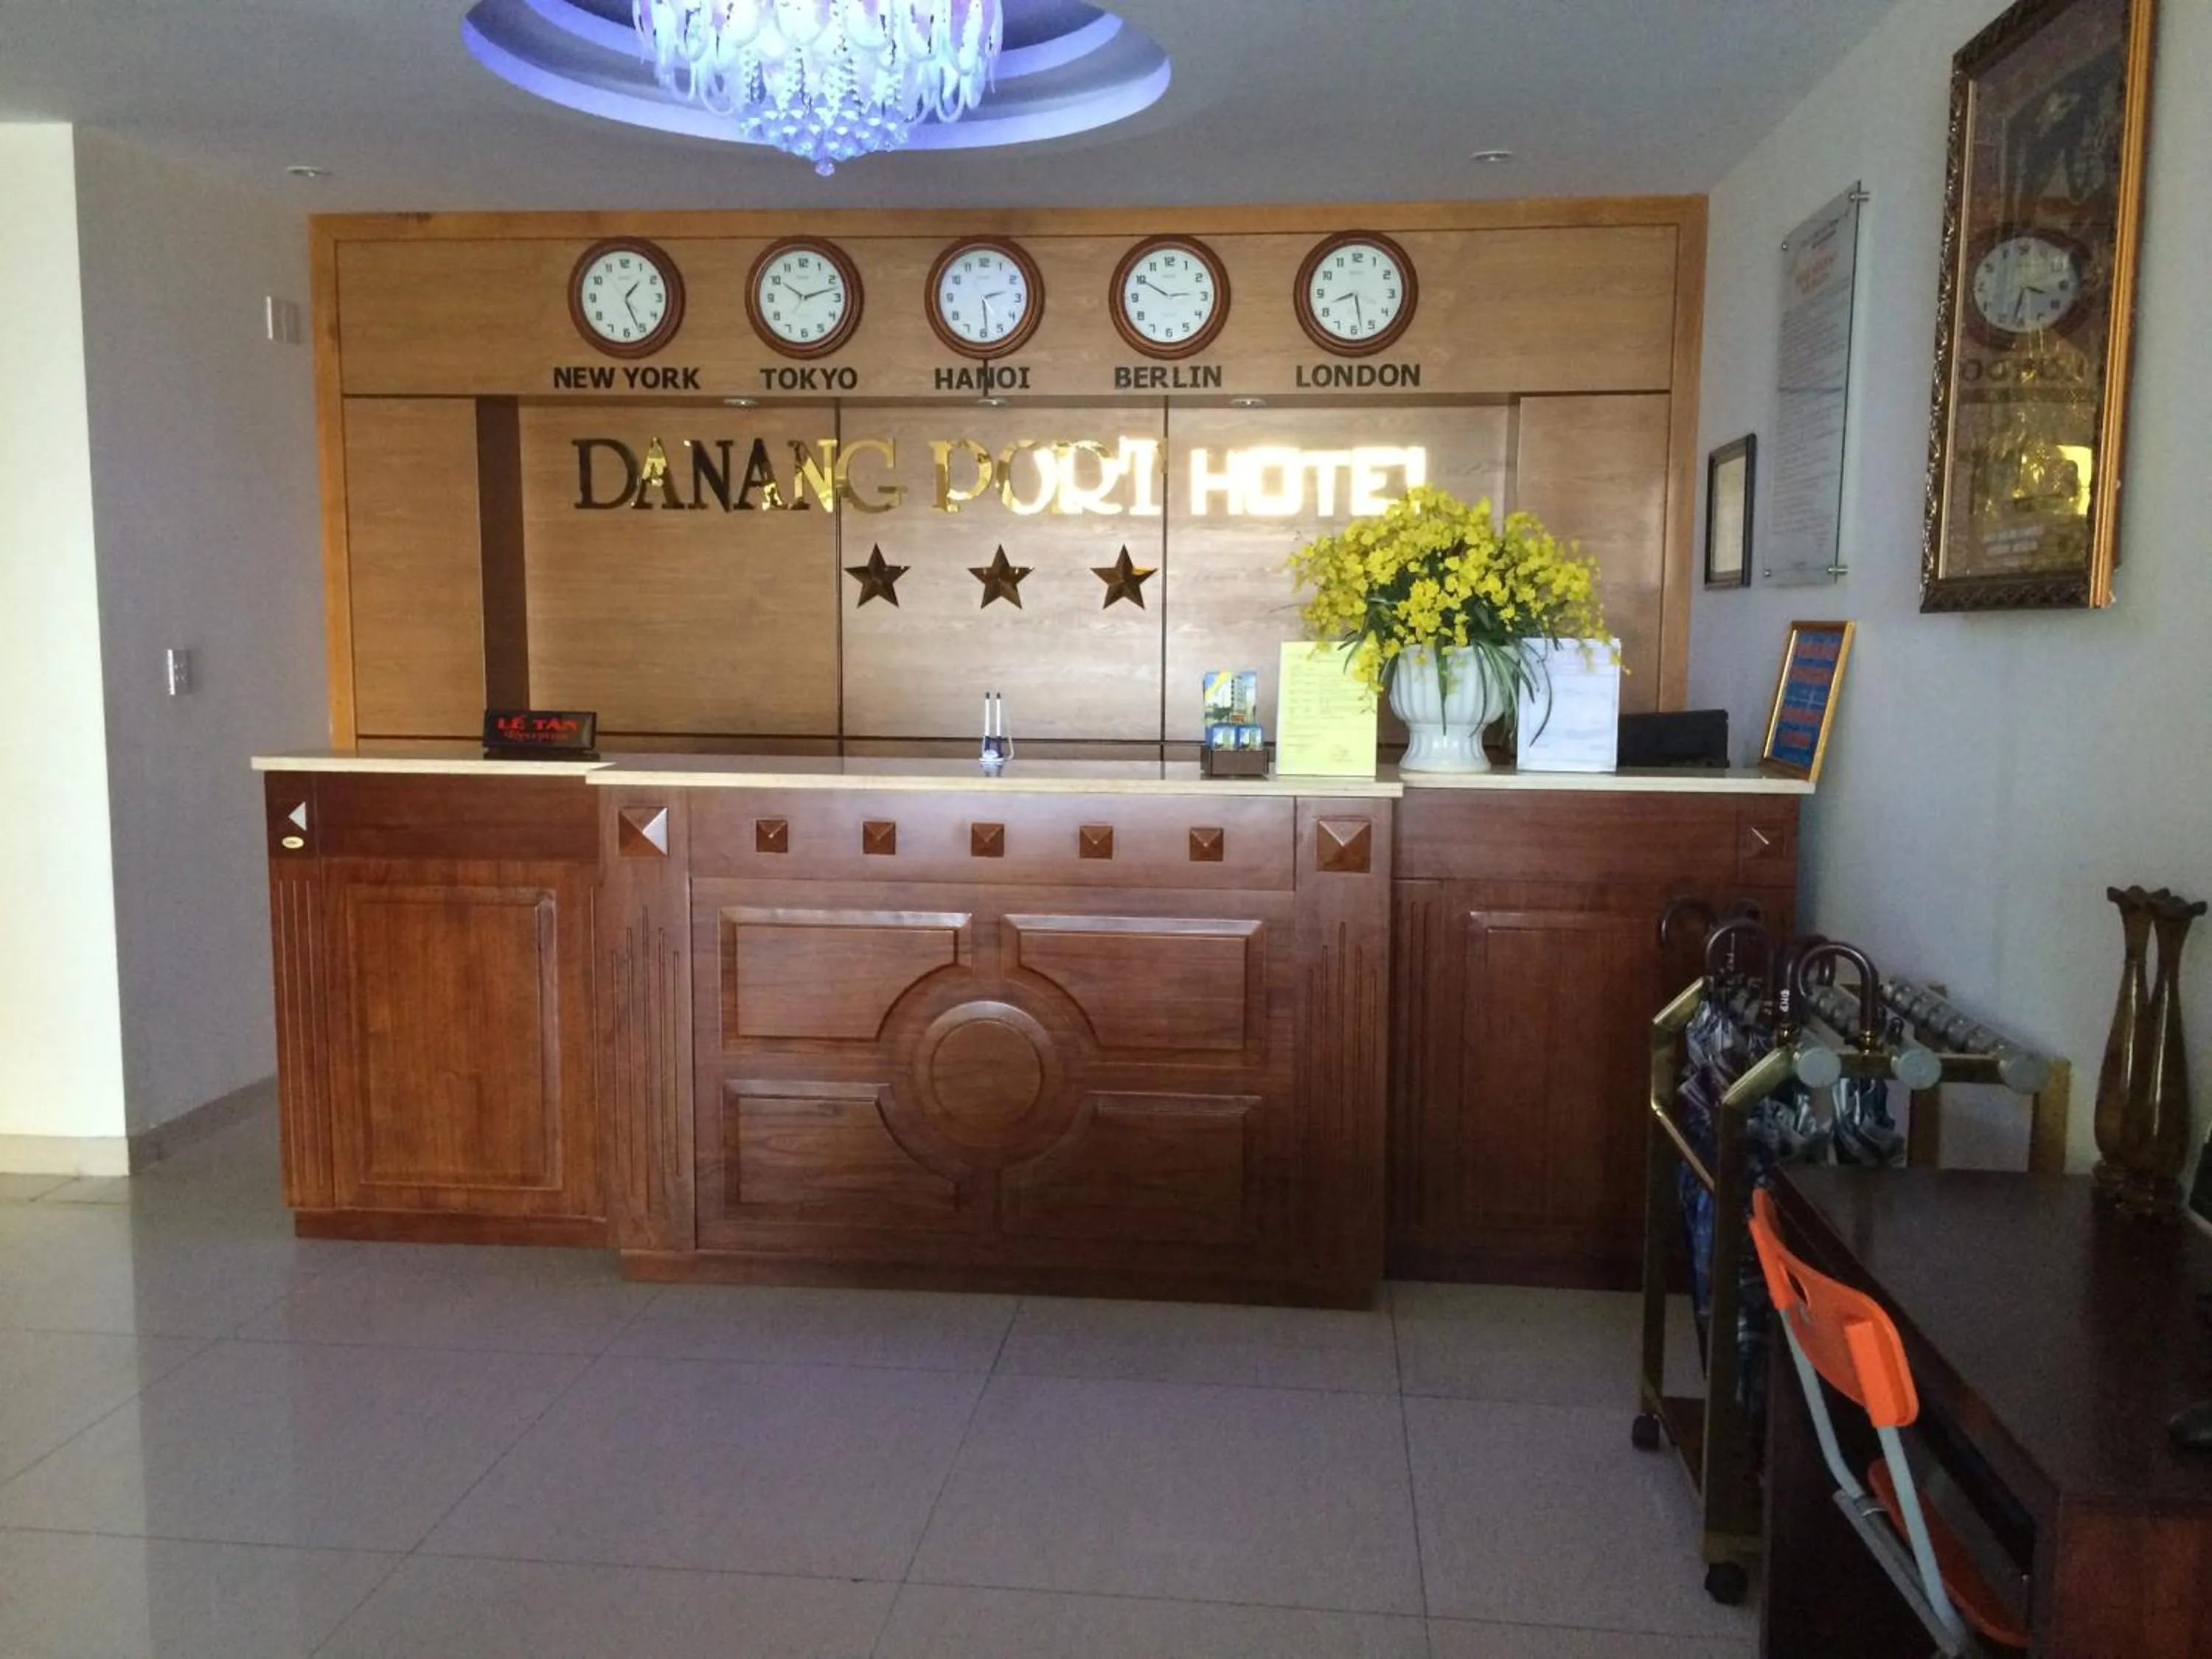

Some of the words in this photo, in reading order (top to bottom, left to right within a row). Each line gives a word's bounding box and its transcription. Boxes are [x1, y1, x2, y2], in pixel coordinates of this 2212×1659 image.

[1164, 257, 1175, 266] 12
[1352, 253, 1363, 262] 12
[1373, 257, 1376, 266] 1
[619, 259, 630, 268] 12
[639, 262, 642, 271] 1
[798, 258, 808, 268] 12
[818, 262, 821, 271] 1
[964, 262, 971, 271] 11
[979, 258, 990, 267] 12
[999, 262, 1002, 271] 1
[1150, 262, 1156, 271] 11
[1183, 261, 1188, 270] 1
[1336, 258, 1343, 267] 11
[605, 264, 612, 272] 11
[784, 263, 790, 272] 11
[1195, 273, 1203, 282] 2
[1323, 271, 1332, 280] 10
[1382, 270, 1391, 279] 2
[594, 276, 602, 285] 10
[650, 276, 657, 285] 2
[771, 276, 780, 285] 10
[828, 275, 835, 284] 2
[952, 275, 961, 285] 10
[1009, 275, 1017, 284] 2
[1136, 275, 1146, 284] 10
[589, 293, 597, 302] 9
[655, 293, 662, 302] 3
[767, 293, 774, 302] 9
[833, 293, 841, 302] 3
[947, 293, 953, 302] 9
[1015, 293, 1020, 302] 3
[1131, 293, 1138, 302] 9
[1200, 292, 1208, 301] 3
[1317, 289, 1324, 298] 9
[1388, 289, 1395, 298] 3
[596, 311, 602, 320] 8
[650, 311, 657, 320] 4
[773, 311, 780, 320] 8
[829, 311, 835, 320] 4
[953, 311, 959, 320] 8
[1009, 311, 1015, 321] 4
[1137, 311, 1144, 320] 8
[1194, 310, 1202, 319] 4
[1322, 307, 1329, 317] 8
[1382, 308, 1388, 316] 4
[607, 324, 613, 333] 7
[639, 323, 646, 333] 5
[785, 324, 791, 333] 7
[817, 324, 824, 333] 5
[964, 324, 970, 333] 7
[997, 324, 1003, 333] 5
[1149, 324, 1155, 333] 7
[1183, 323, 1189, 332] 5
[1334, 321, 1340, 330] 7
[1368, 320, 1375, 330] 5
[624, 328, 630, 337] 6
[801, 329, 808, 338] 6
[980, 329, 987, 338] 6
[1166, 328, 1172, 337] 6
[1351, 326, 1357, 335] 6
[554, 368, 615, 389] NEW
[624, 368, 701, 389] YORK
[759, 368, 858, 389] TOKYO
[934, 367, 1031, 389] HANOI
[1114, 366, 1222, 389] BERLIN
[1295, 364, 1421, 388] LONDON
[572, 437, 907, 513] DANANG
[928, 436, 1167, 515] PORT
